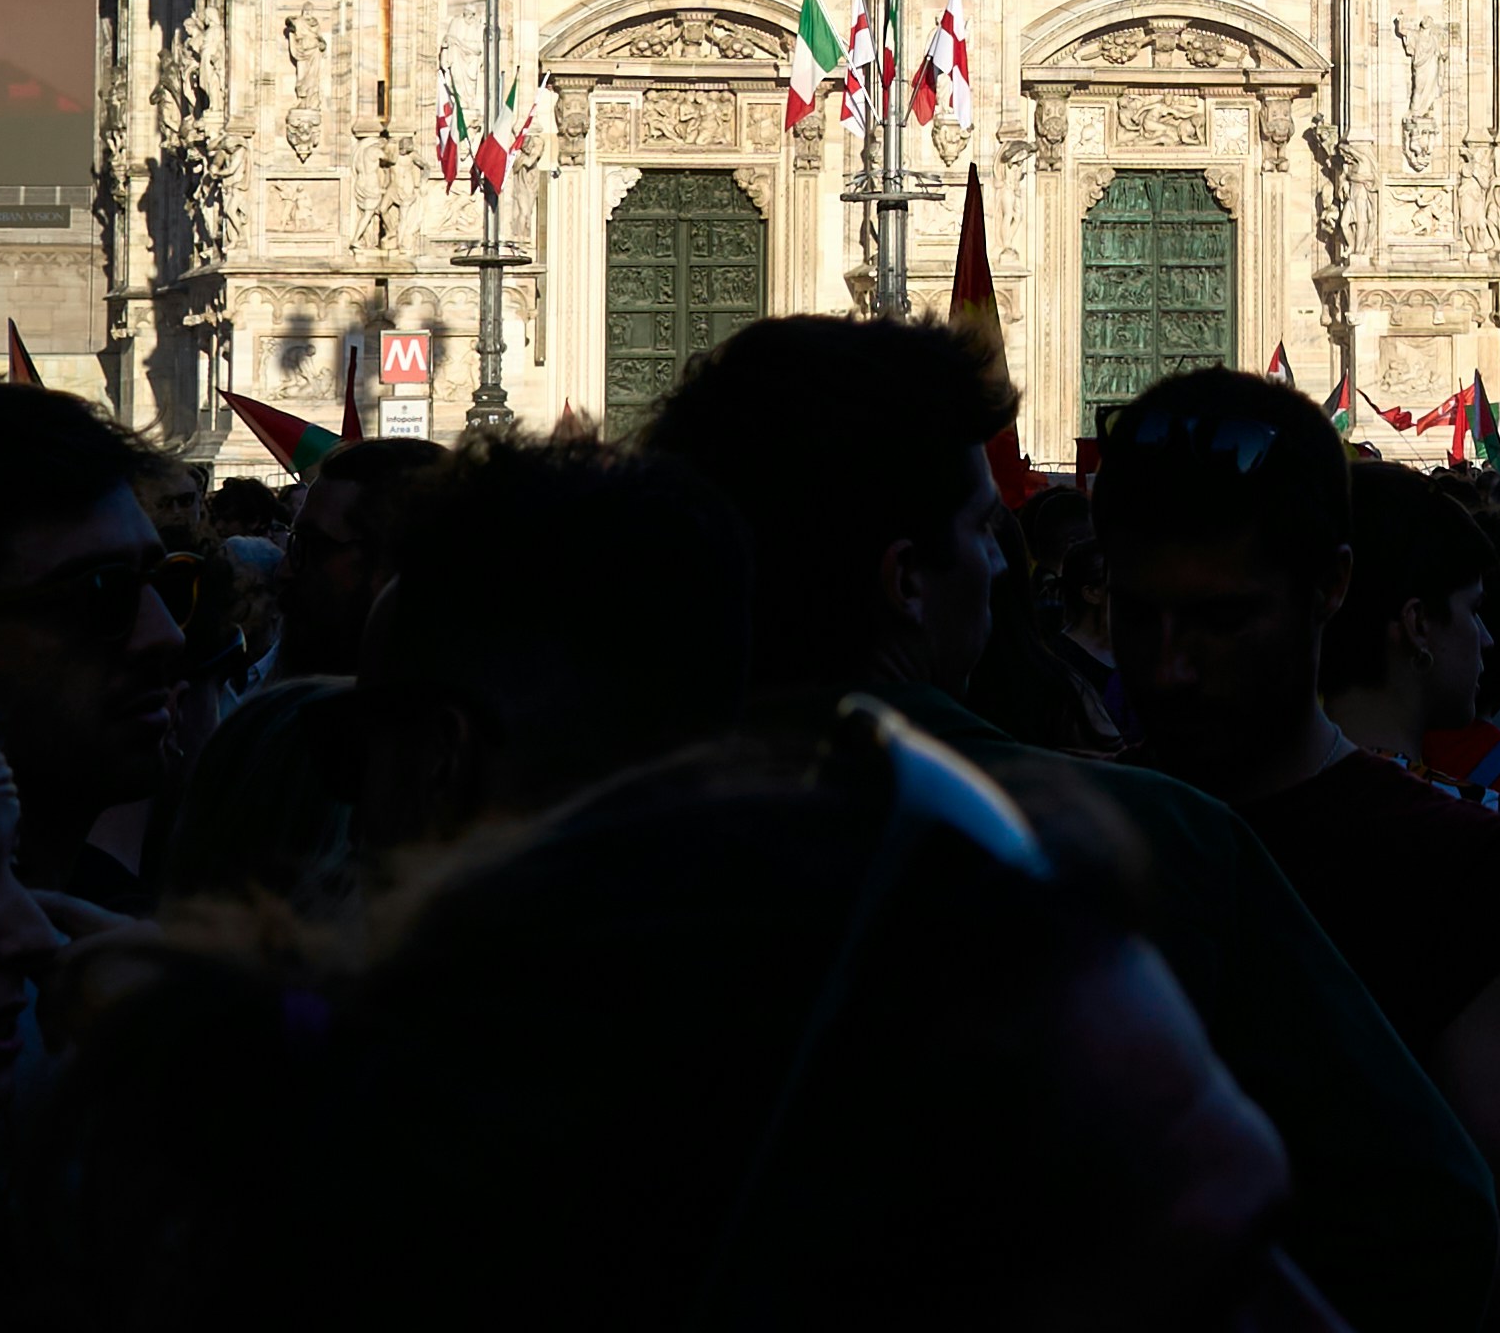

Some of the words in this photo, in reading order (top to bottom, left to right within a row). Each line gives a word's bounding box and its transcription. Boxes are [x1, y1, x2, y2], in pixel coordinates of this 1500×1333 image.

[26, 211, 65, 222] VISION
[383, 339, 428, 372] M
[390, 425, 411, 434] Area
